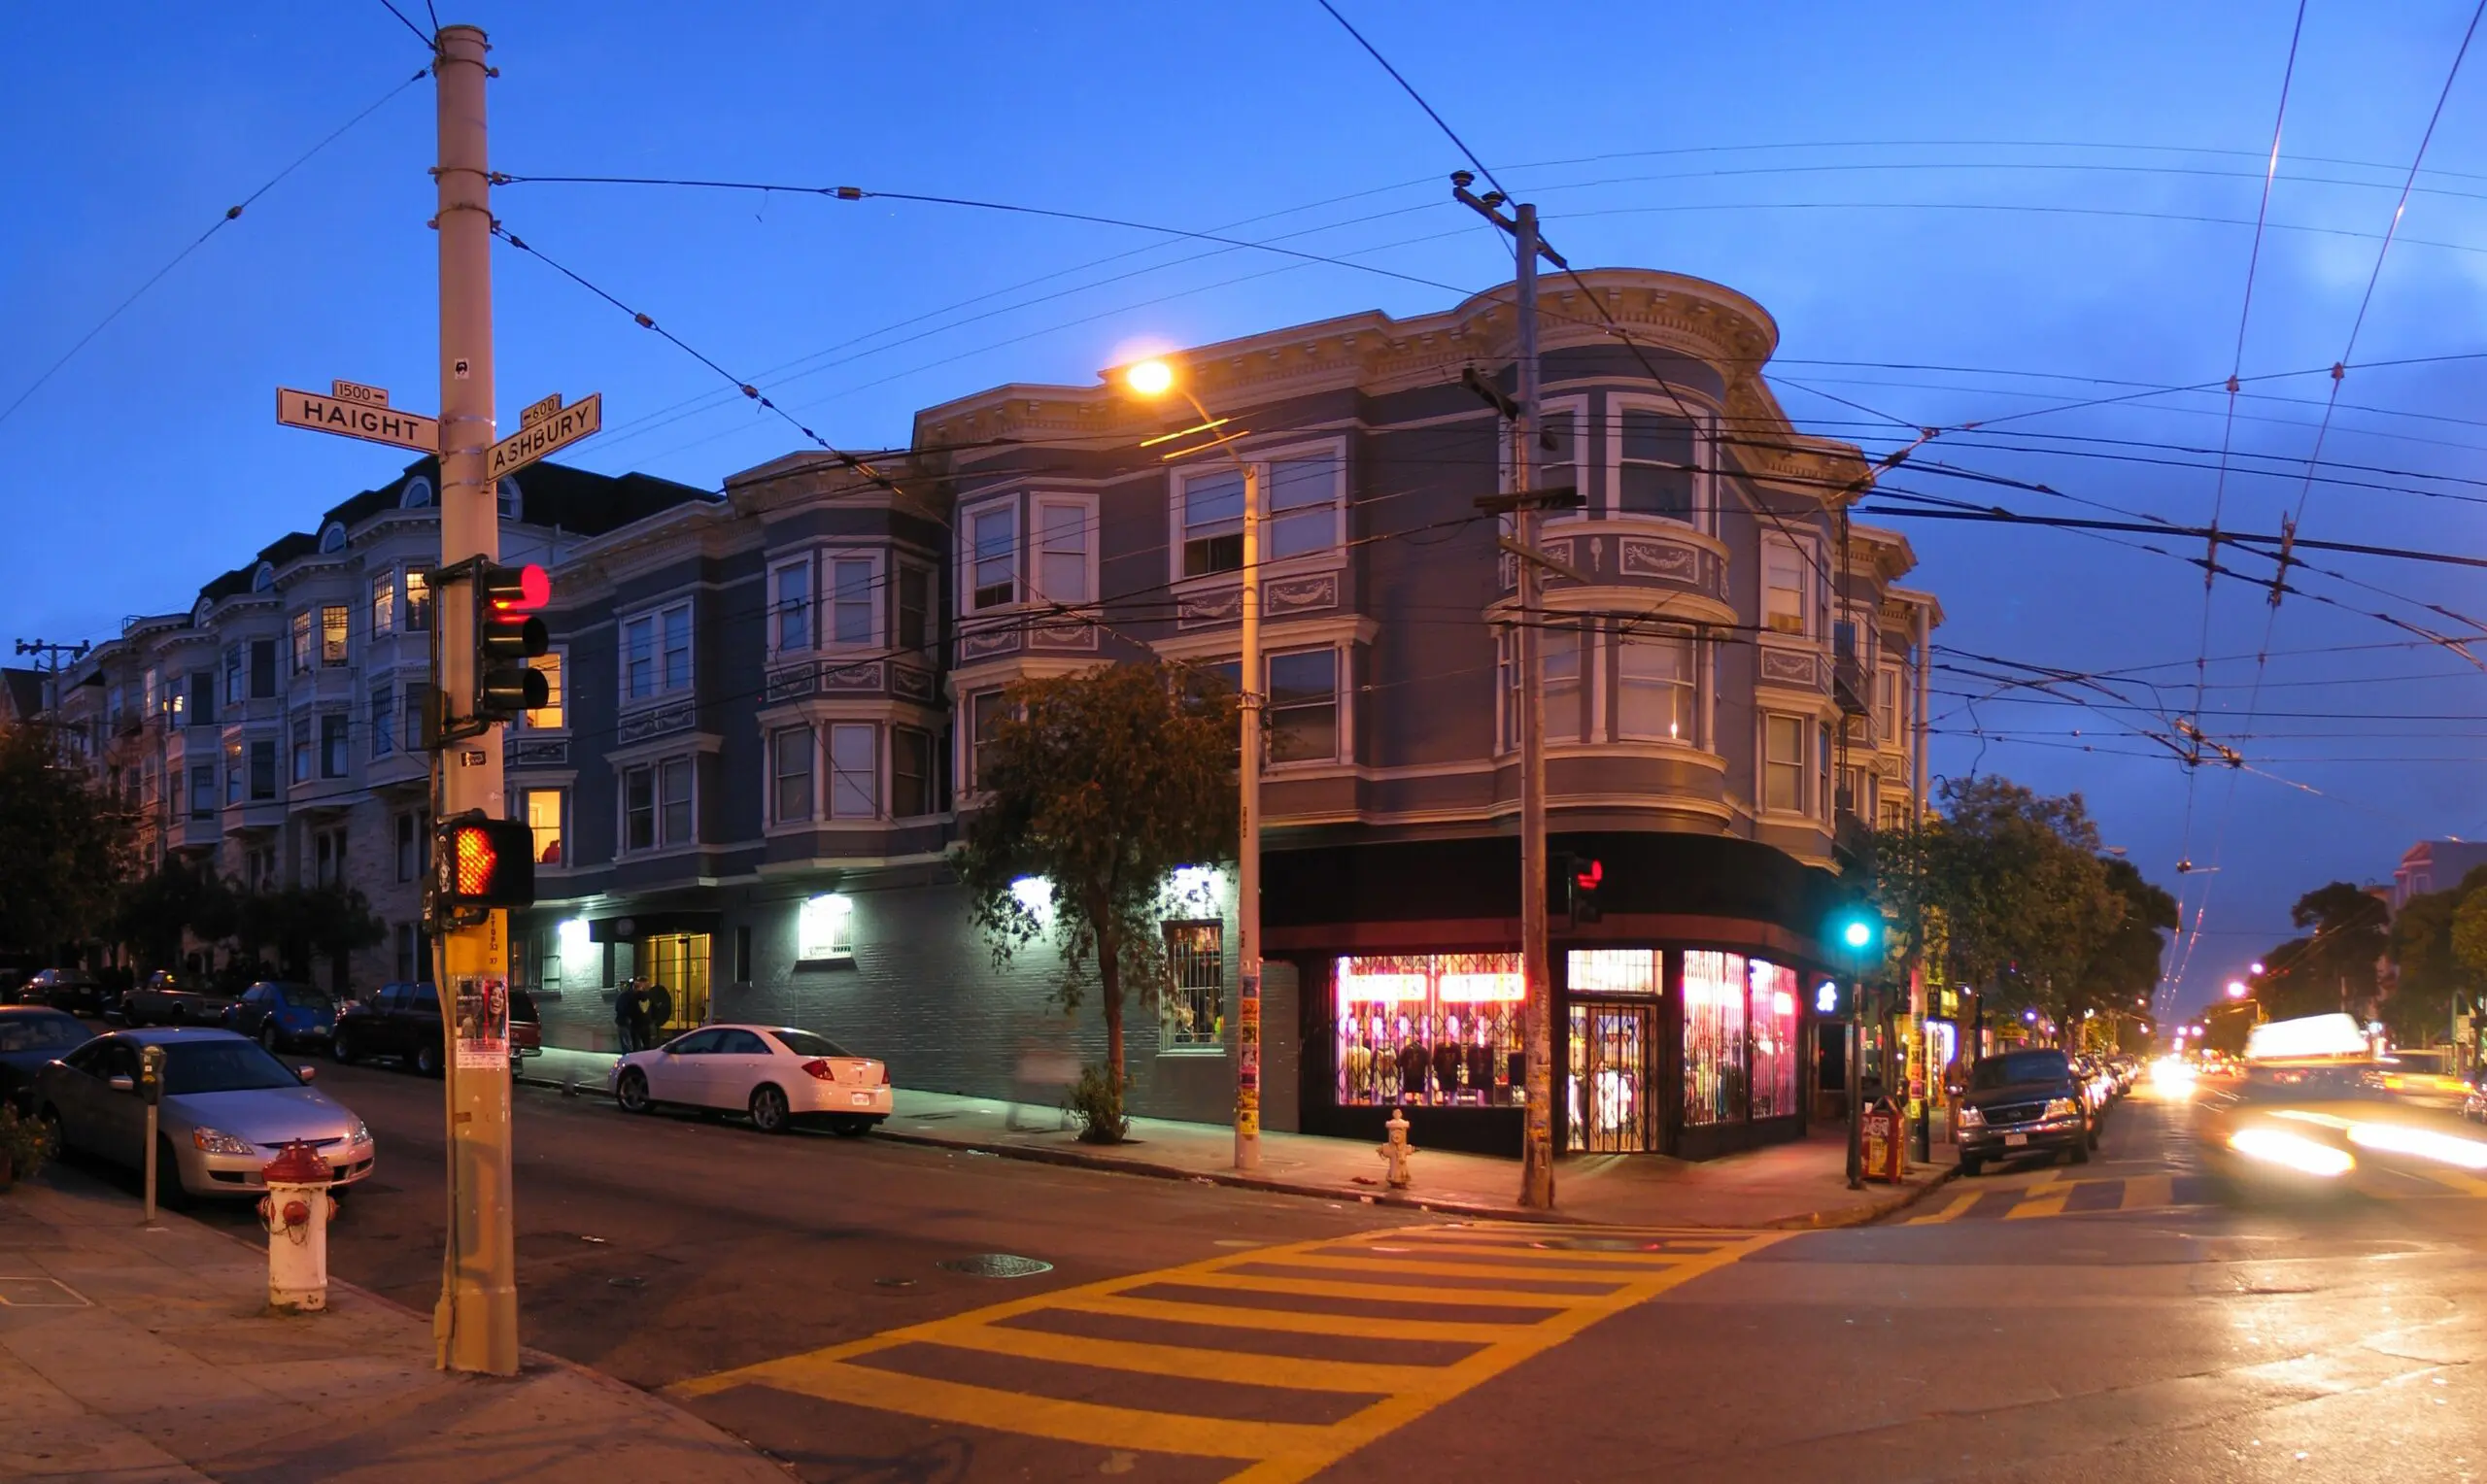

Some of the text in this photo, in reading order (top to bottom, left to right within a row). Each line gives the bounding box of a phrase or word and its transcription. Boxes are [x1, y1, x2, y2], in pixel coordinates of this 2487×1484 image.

[339, 383, 370, 400] 1500
[304, 400, 419, 440] HAIGHT
[532, 398, 555, 419] 600
[494, 406, 589, 471] ASHBURY
